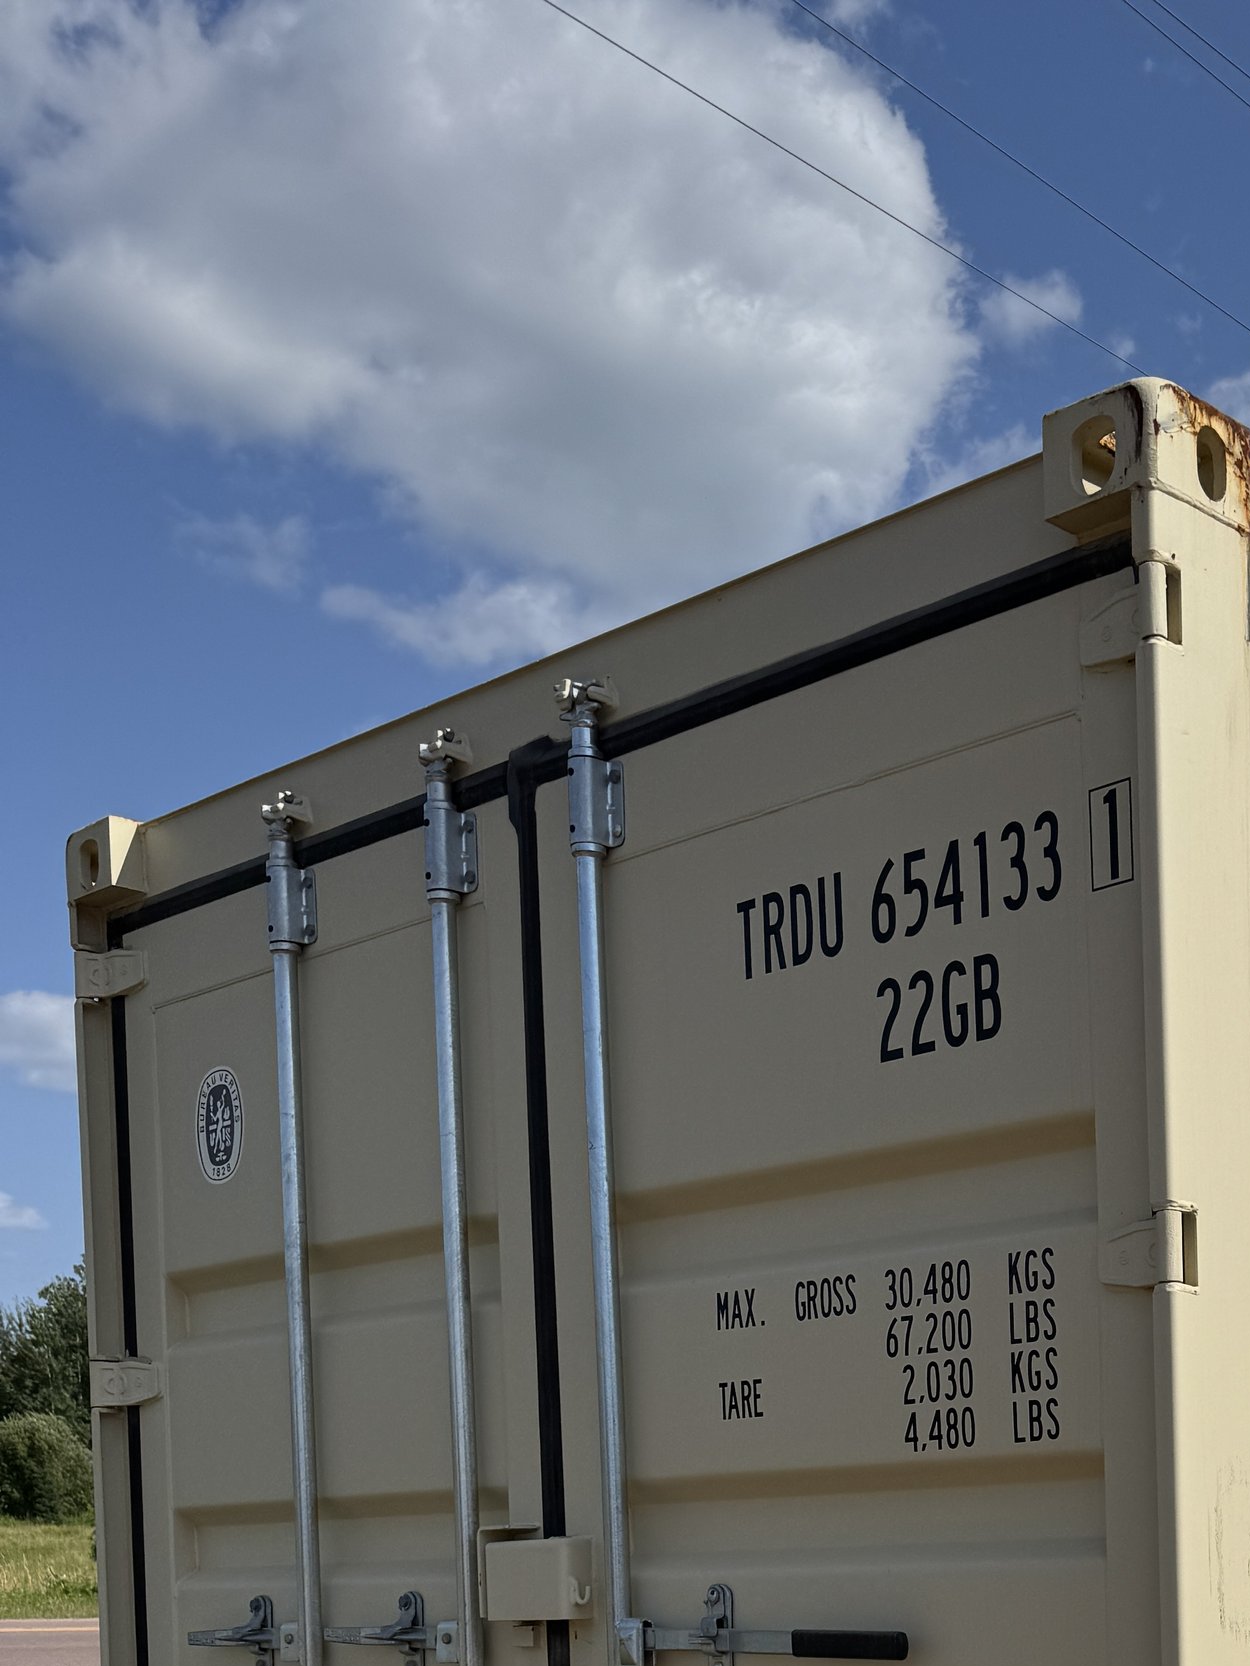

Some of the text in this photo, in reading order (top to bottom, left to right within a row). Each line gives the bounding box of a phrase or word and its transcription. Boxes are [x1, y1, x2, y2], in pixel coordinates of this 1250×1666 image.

[737, 787, 1121, 979] TRDU 654133 1
[876, 953, 1002, 1063] 22GB
[211, 1162, 232, 1177] 1828
[716, 1247, 1055, 1331] MAX. GROSS 30,480 KGS
[886, 1298, 1057, 1358] 67,200 LBS
[719, 1347, 1059, 1420] TARE 2,030 KGS
[904, 1398, 1060, 1453] 4,480 LBS
